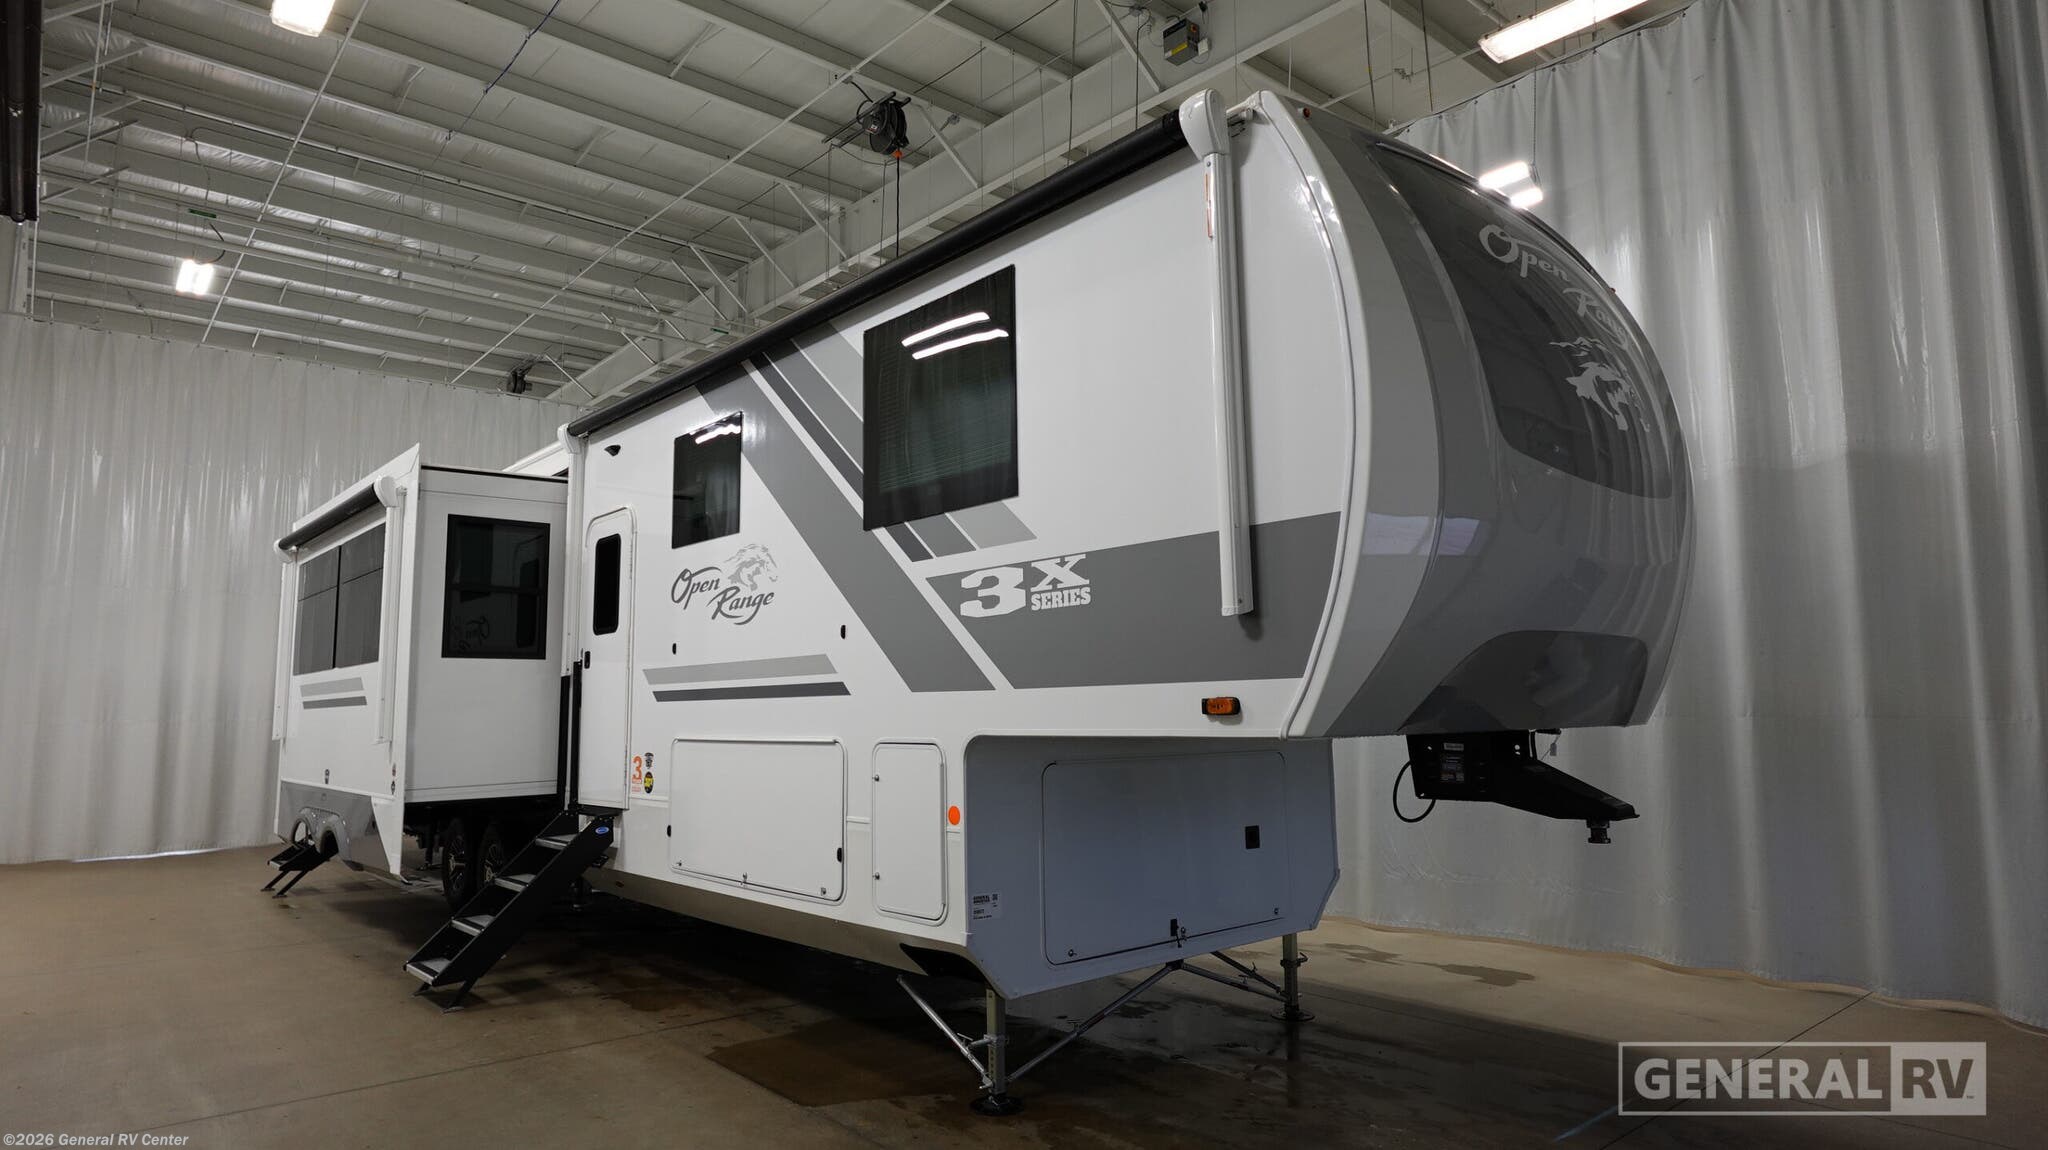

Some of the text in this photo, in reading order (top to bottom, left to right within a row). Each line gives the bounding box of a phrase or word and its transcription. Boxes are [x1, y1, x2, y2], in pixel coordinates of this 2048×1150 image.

[1479, 224, 1571, 282] Open
[671, 566, 722, 610] Open
[706, 585, 775, 625] Range
[1031, 586, 1091, 611] SERIES
